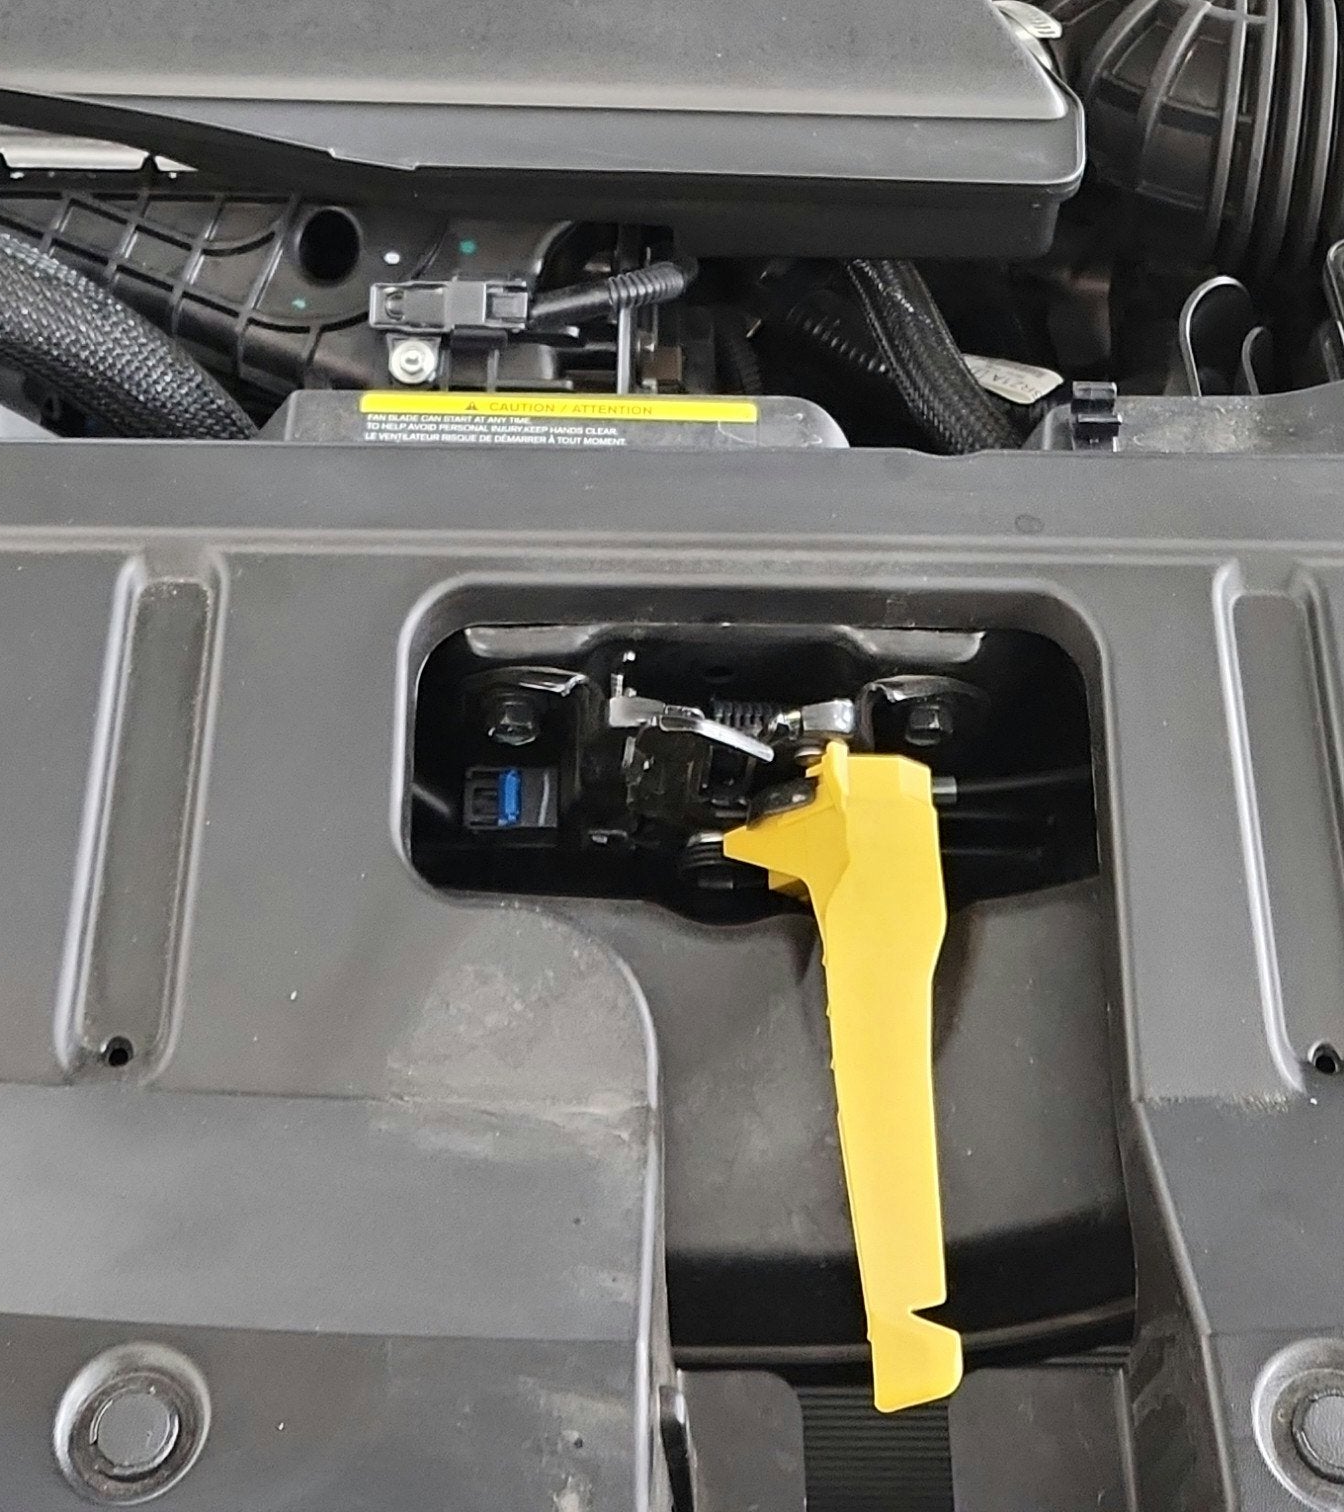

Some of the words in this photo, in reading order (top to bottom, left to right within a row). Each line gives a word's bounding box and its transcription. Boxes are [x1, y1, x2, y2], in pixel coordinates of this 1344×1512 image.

[489, 402, 555, 413] CAUTION
[572, 404, 653, 415] ATTENTION
[367, 414, 386, 422] FAN
[388, 414, 418, 422] BLADE
[444, 415, 472, 423] START
[487, 416, 506, 424] ANY
[366, 422, 380, 430] TO
[381, 423, 407, 431] HELP
[408, 423, 437, 431] AVOID
[439, 424, 489, 432] PERSONAL
[550, 426, 583, 435] HANDS
[365, 432, 375, 440] LE
[379, 432, 439, 442] VENTILATEUR
[441, 433, 476, 442] RISQUE
[479, 434, 492, 442] DE
[494, 433, 546, 443] DÉMARRER
[547, 434, 555, 444] À
[557, 436, 581, 444] TOUT
